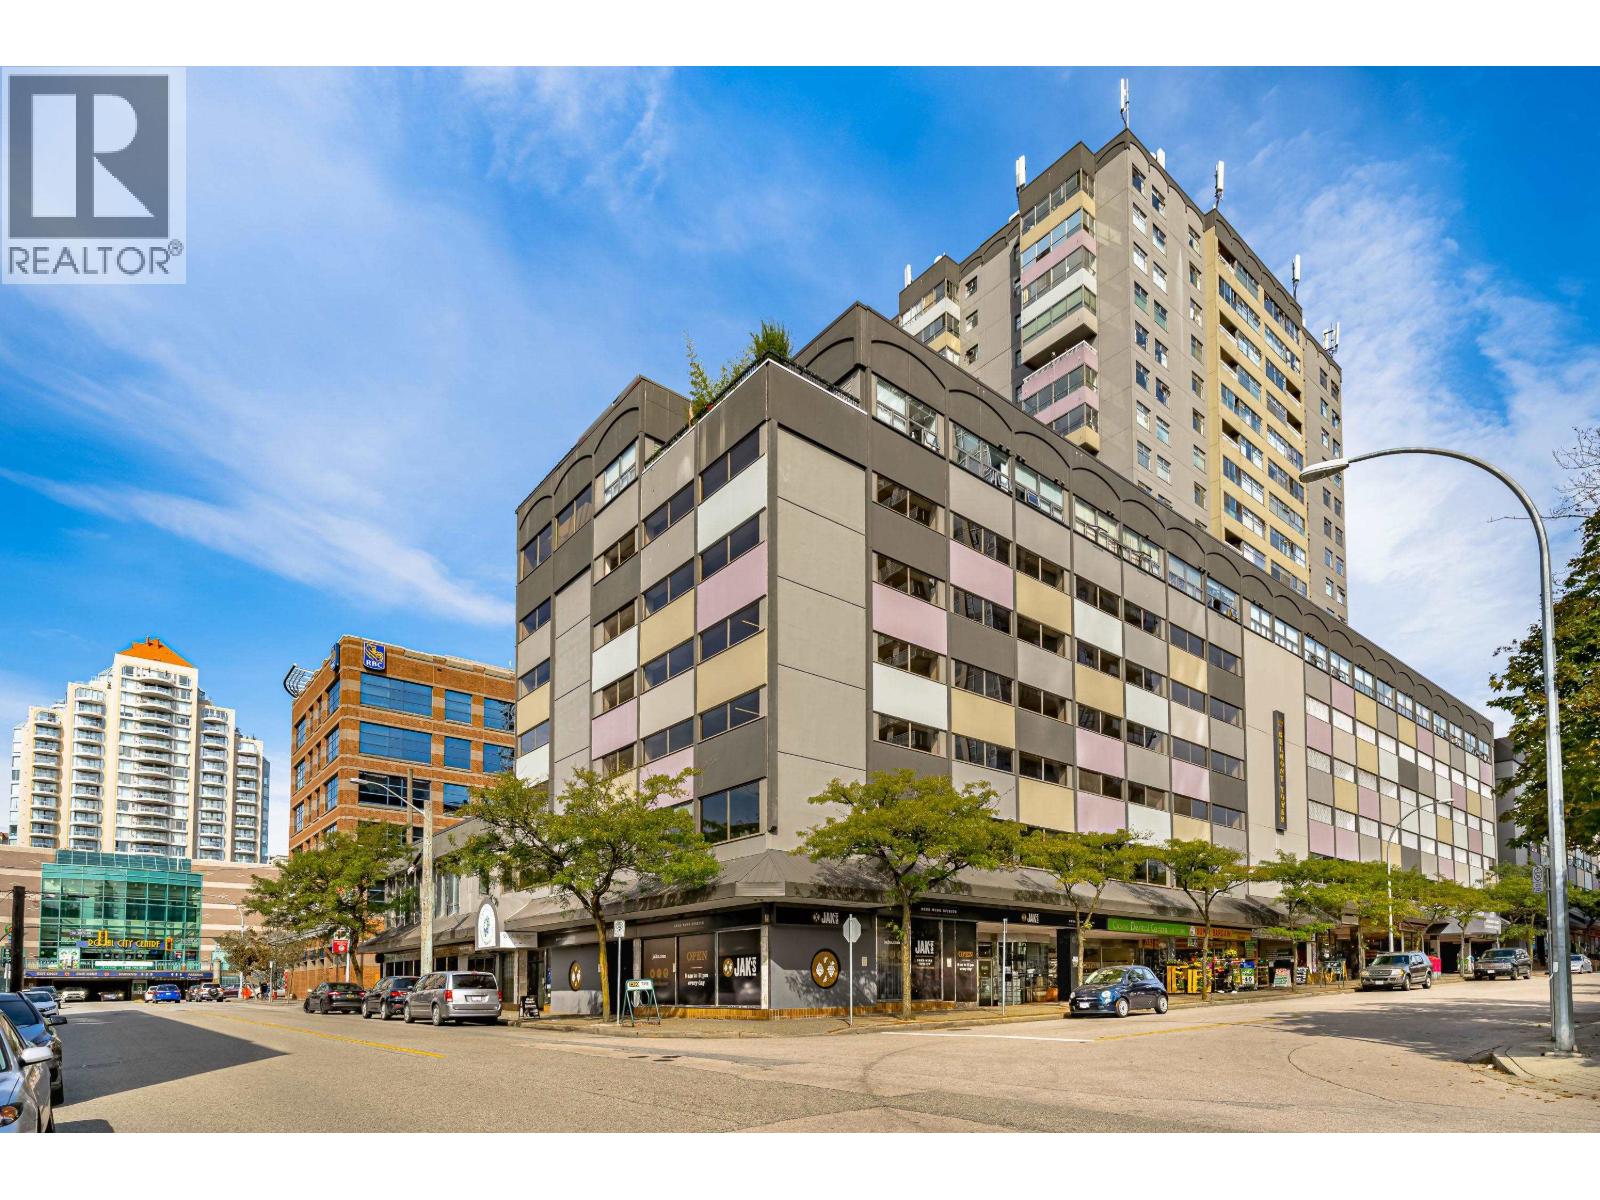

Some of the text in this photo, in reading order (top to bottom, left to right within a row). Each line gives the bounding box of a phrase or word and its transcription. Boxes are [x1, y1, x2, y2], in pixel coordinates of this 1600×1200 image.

[366, 660, 382, 668] RBC
[117, 939, 133, 948] CITY
[136, 939, 161, 949] CENTRE
[686, 950, 708, 962] OPEN
[734, 956, 757, 977] JAK'S
